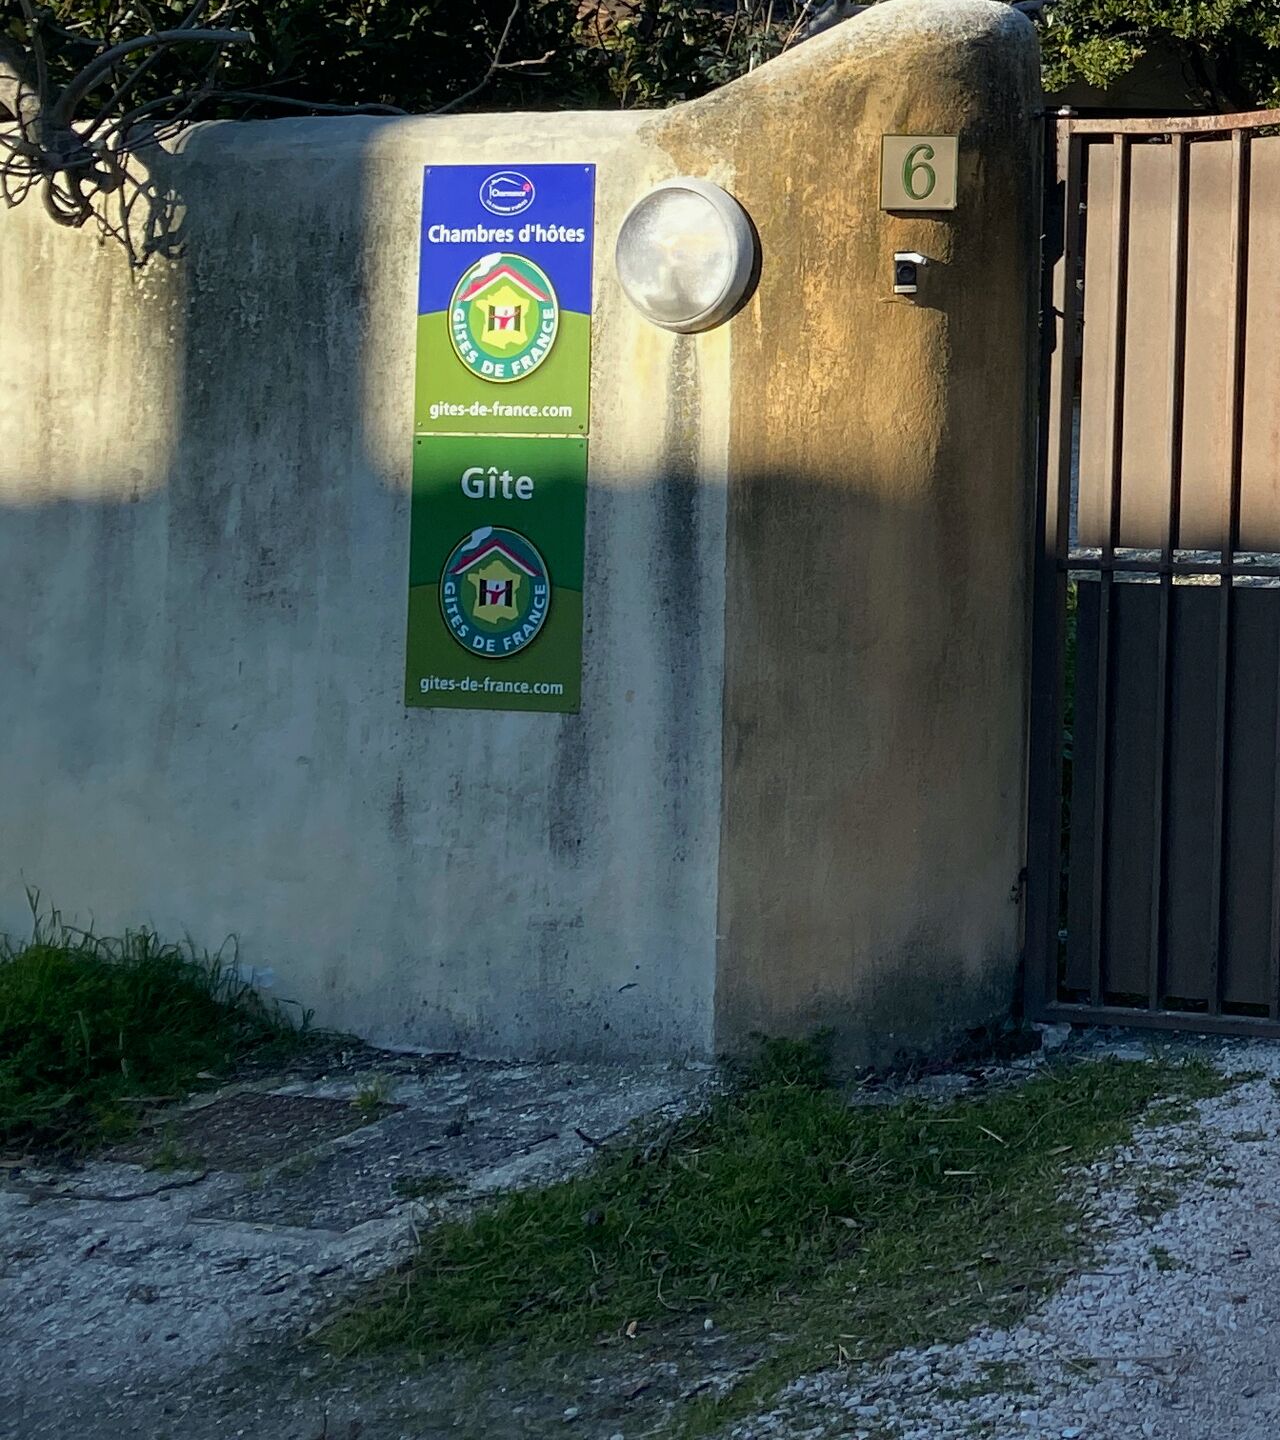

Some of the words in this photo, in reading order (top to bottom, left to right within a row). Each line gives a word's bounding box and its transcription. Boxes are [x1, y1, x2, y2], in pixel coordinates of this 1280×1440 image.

[902, 143, 936, 201] 6
[428, 224, 514, 244] Chambres
[518, 224, 586, 244] d'hôtes
[480, 360, 505, 377] DE
[511, 308, 554, 375] FRANCE
[429, 401, 572, 419] gites-de-france.com
[461, 466, 534, 500] Gîte
[472, 635, 495, 652] DE
[503, 584, 546, 650] FRANCE
[420, 675, 564, 695] gites-de-france.com
